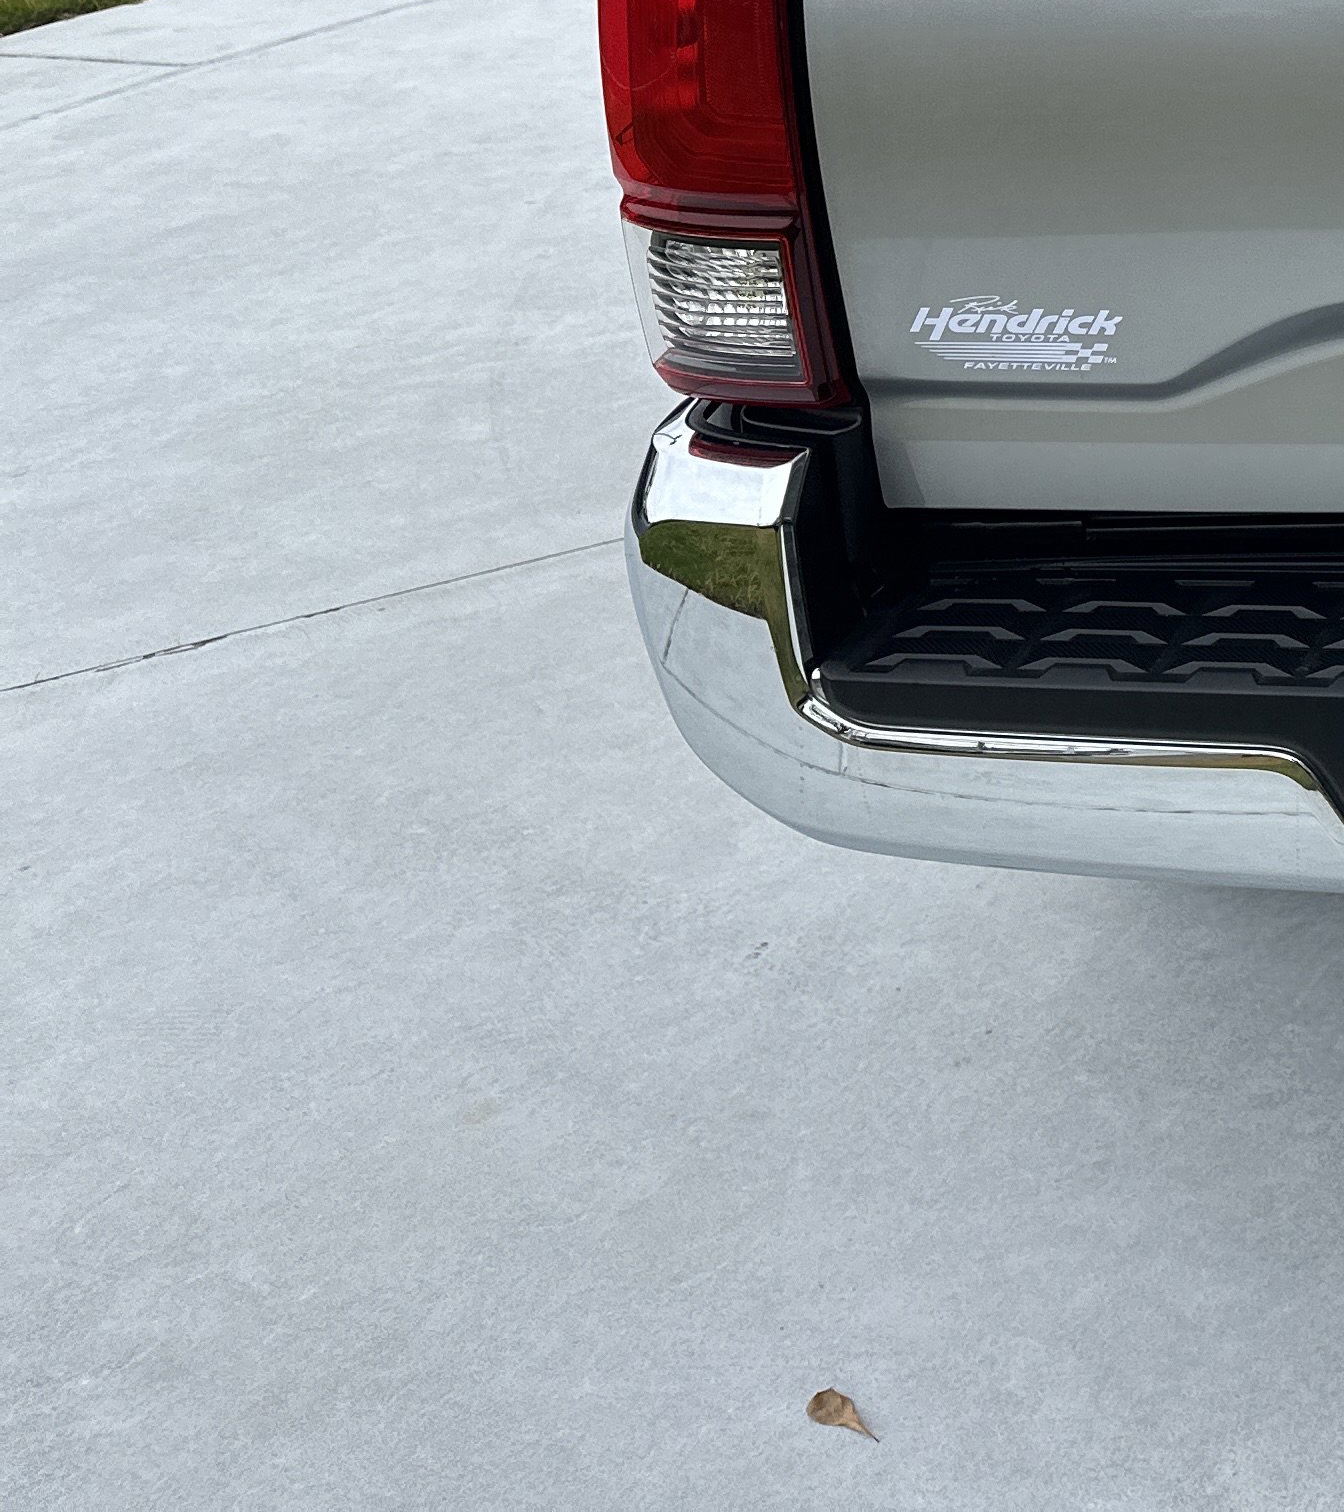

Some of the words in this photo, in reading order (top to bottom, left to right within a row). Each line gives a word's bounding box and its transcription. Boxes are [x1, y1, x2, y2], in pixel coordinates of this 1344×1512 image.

[909, 307, 1124, 341] Hendrick
[990, 333, 1070, 342] TOYOTA
[963, 361, 1092, 371] FAYETTEVILLE
